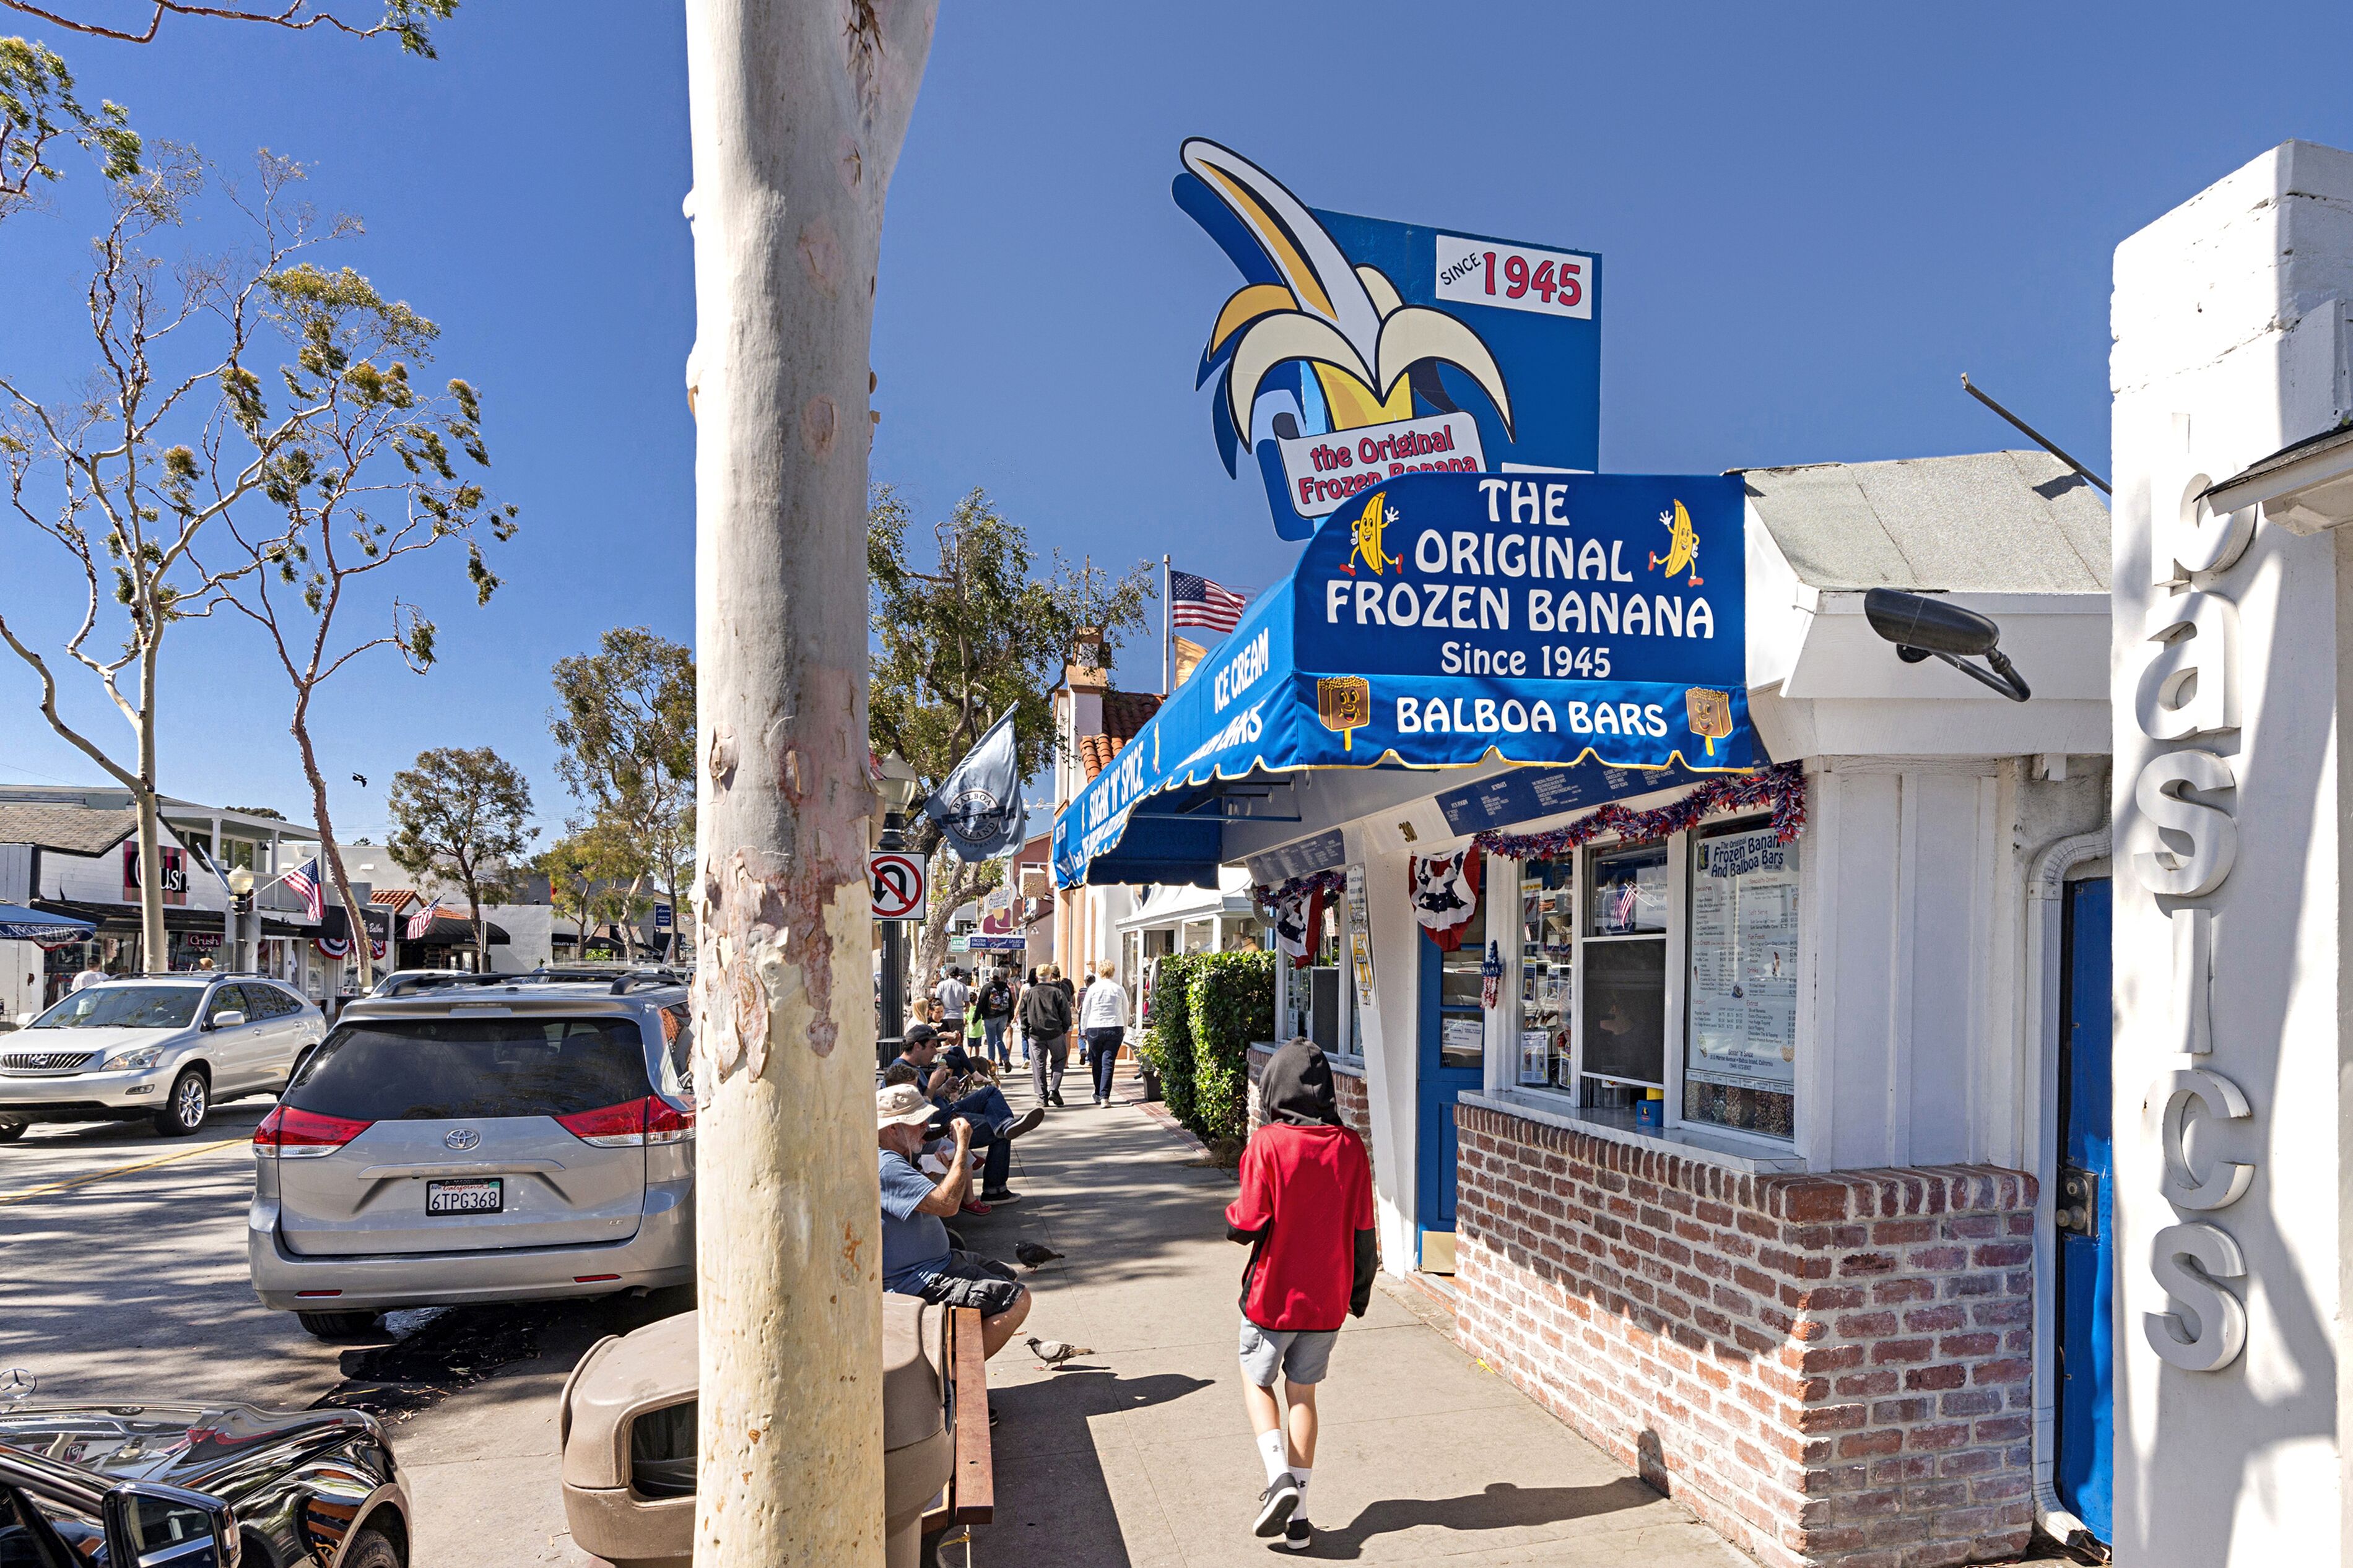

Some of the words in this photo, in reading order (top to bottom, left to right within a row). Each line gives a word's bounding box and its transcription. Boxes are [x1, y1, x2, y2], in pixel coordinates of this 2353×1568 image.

[1440, 252, 1481, 286] SINCE
[1482, 252, 1582, 306] 1945
[1310, 444, 1351, 472] the
[1358, 425, 1455, 464] Original
[1299, 469, 1382, 505] Frozen
[1479, 479, 1570, 526] THE
[1415, 529, 1633, 583] ORIGINAL
[1326, 580, 1510, 630] FROZEN
[1528, 589, 1714, 639] BANANA
[1214, 665, 1230, 714] ICE
[1230, 627, 1269, 698] CREAM
[1441, 641, 1526, 676] Since
[1542, 646, 1611, 678] 1945
[1397, 696, 1557, 734] BALBOA
[1568, 701, 1668, 738] BARS
[1089, 782, 1110, 829] SUGAR
[1121, 740, 1144, 803] SPICE
[954, 794, 991, 809] BALBOA
[955, 833, 1002, 848] CELEBRATION
[959, 822, 995, 838] ISLAND
[1729, 836, 1746, 847] Original
[1711, 864, 1727, 877] And
[1730, 855, 1759, 877] Balboa
[1762, 850, 1783, 865] Bars
[1714, 846, 1745, 862] Frozen
[1748, 834, 1785, 853] Banan
[190, 935, 219, 945] Crush
[411, 1167, 510, 1177] SIENNA
[443, 1184, 485, 1192] California
[432, 1192, 497, 1210] 6TPG368
